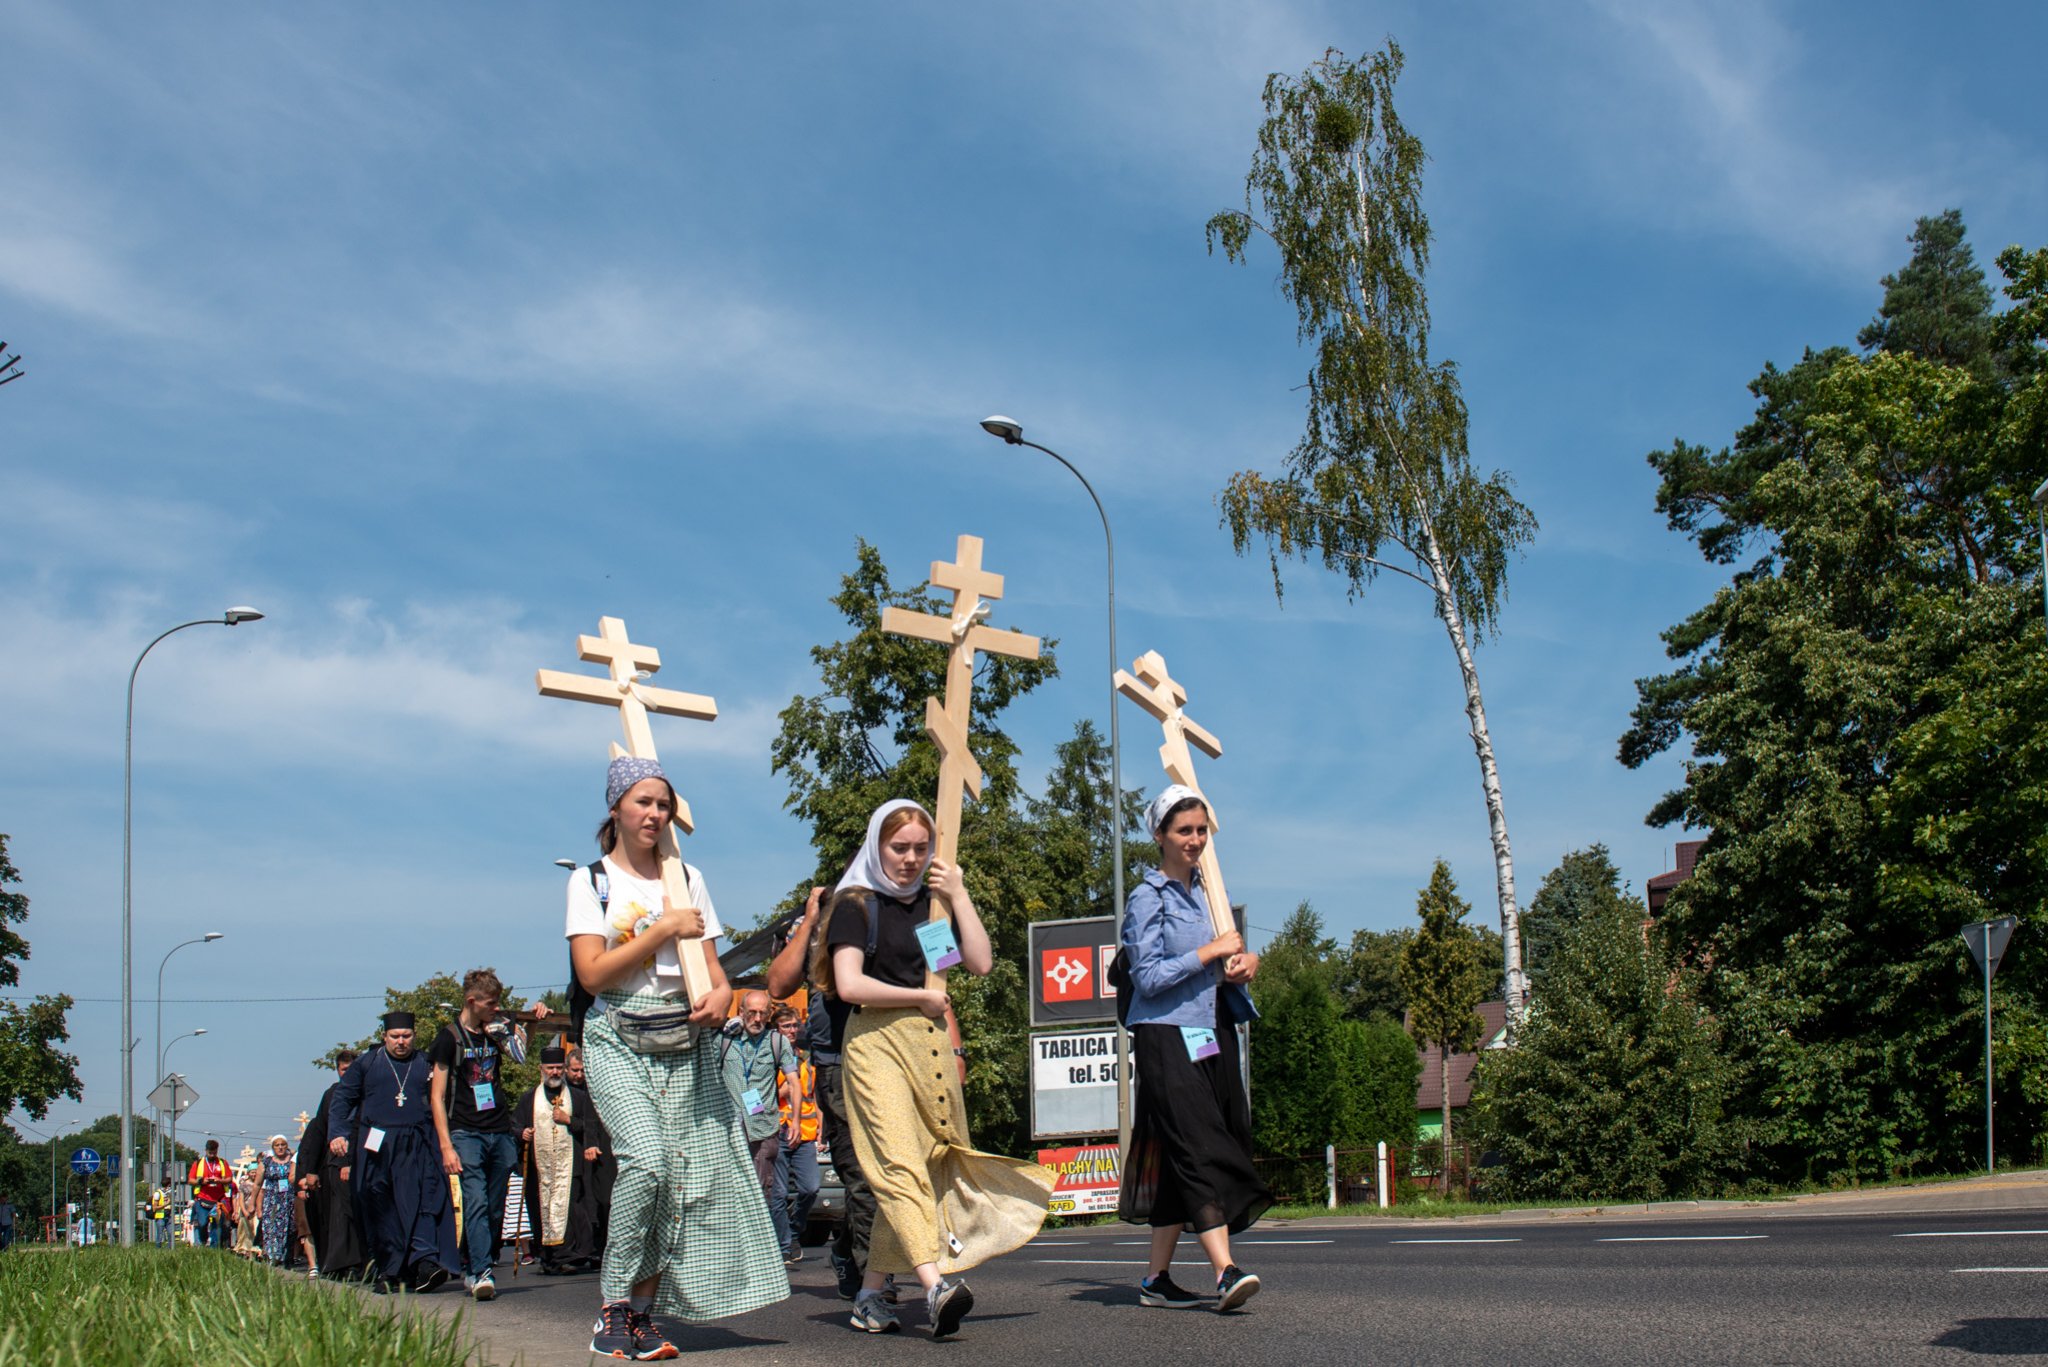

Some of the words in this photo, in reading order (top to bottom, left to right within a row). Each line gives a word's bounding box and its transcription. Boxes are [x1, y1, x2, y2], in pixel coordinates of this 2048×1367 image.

[1039, 1037, 1108, 1059] TABLICA
[1069, 1065, 1096, 1084] tel.
[1096, 1158, 1114, 1172] NA
